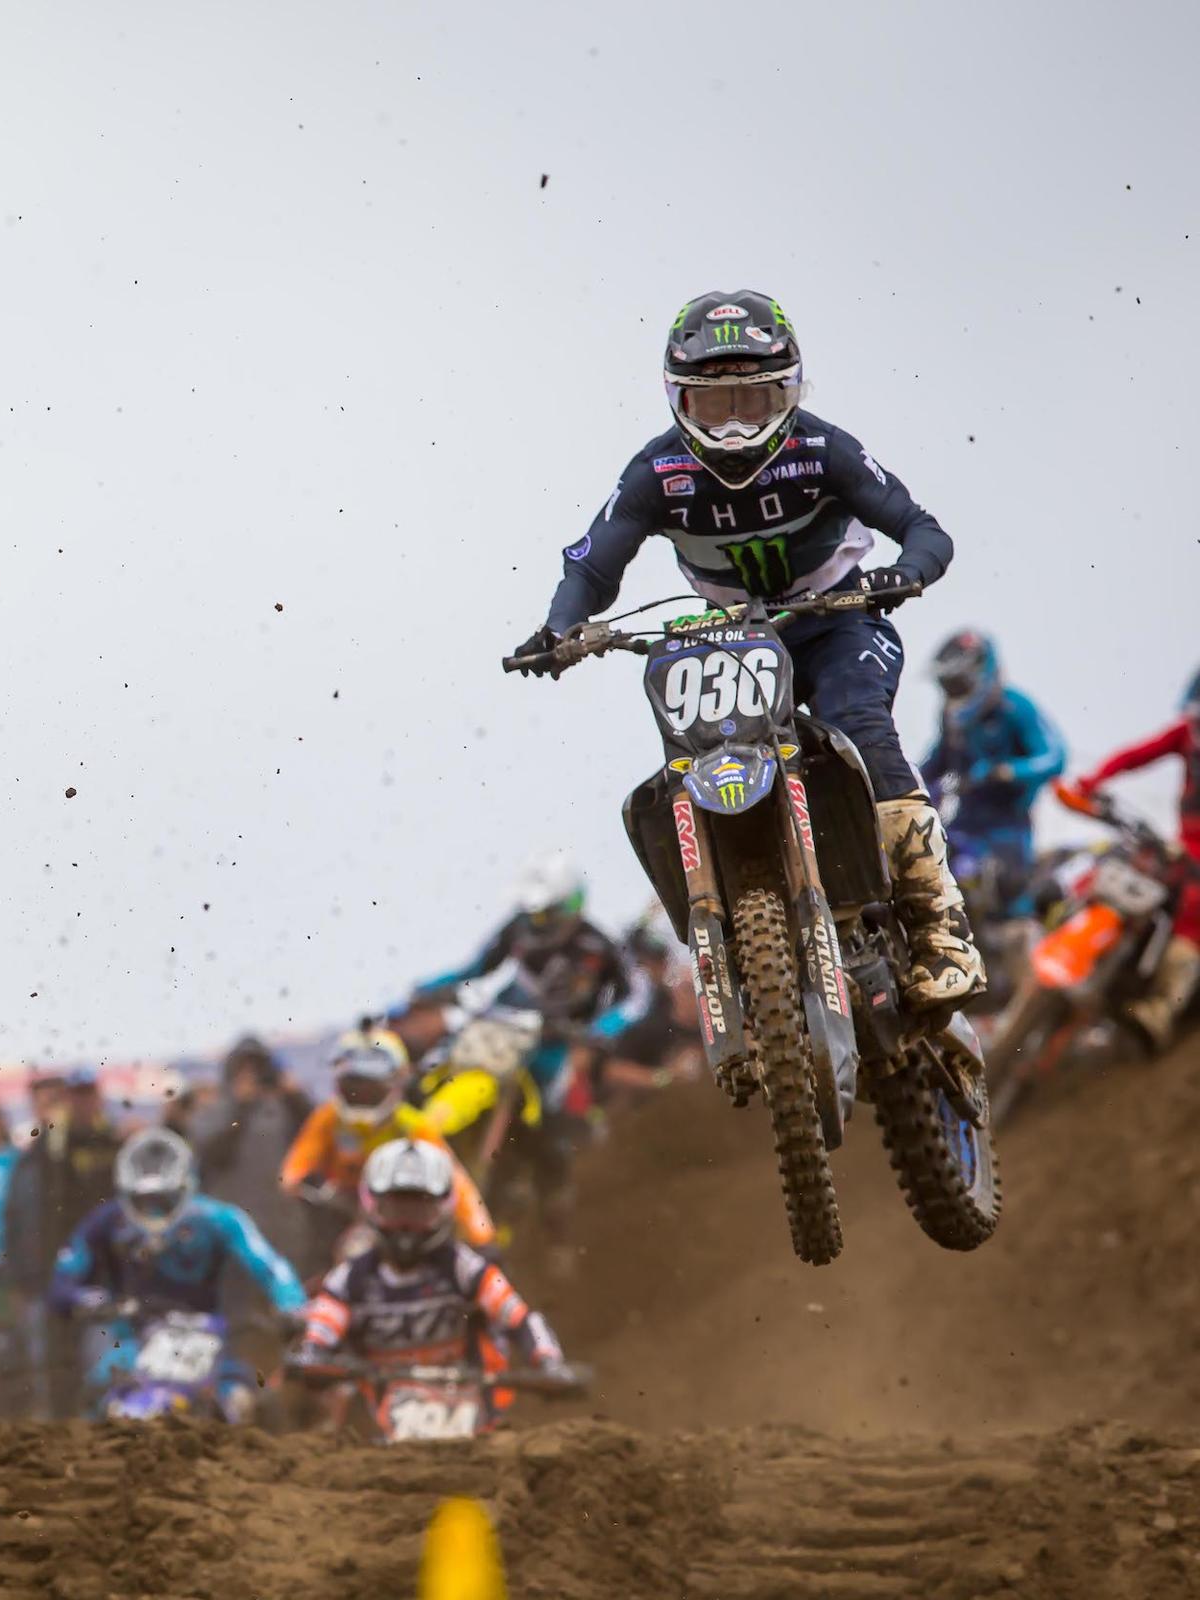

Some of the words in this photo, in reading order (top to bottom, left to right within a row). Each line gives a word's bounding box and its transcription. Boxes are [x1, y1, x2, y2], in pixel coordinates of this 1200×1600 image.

[714, 308, 741, 317] BELL
[771, 461, 825, 481] YAMAHA
[725, 630, 746, 642] OIL
[665, 647, 779, 732] 936
